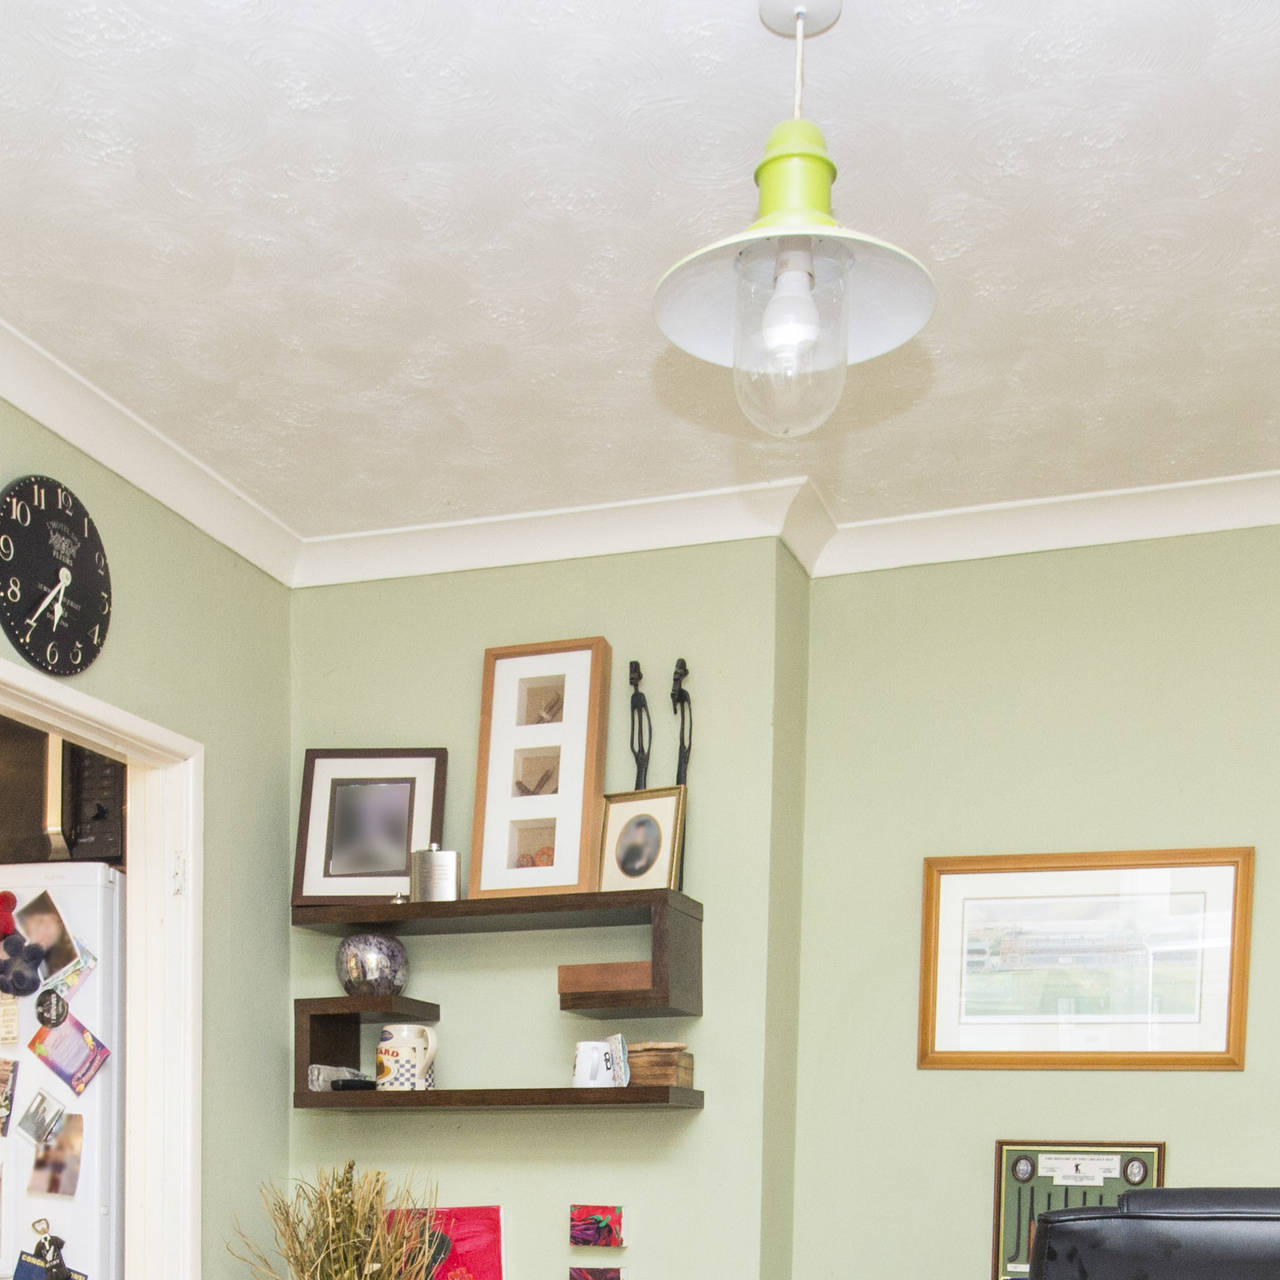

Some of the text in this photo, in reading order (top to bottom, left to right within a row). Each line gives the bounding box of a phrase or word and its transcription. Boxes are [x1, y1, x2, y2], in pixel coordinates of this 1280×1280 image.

[33, 485, 45, 510] 11
[57, 488, 73, 516] 12
[10, 497, 30, 527] 10
[84, 517, 89, 538] 1
[0, 534, 14, 561] 9
[95, 552, 105, 575] 2
[7, 577, 21, 602] 8
[99, 592, 109, 615] 3
[25, 618, 37, 642] 7
[87, 624, 101, 646] 4
[46, 641, 59, 664] 6
[70, 641, 82, 664] 5
